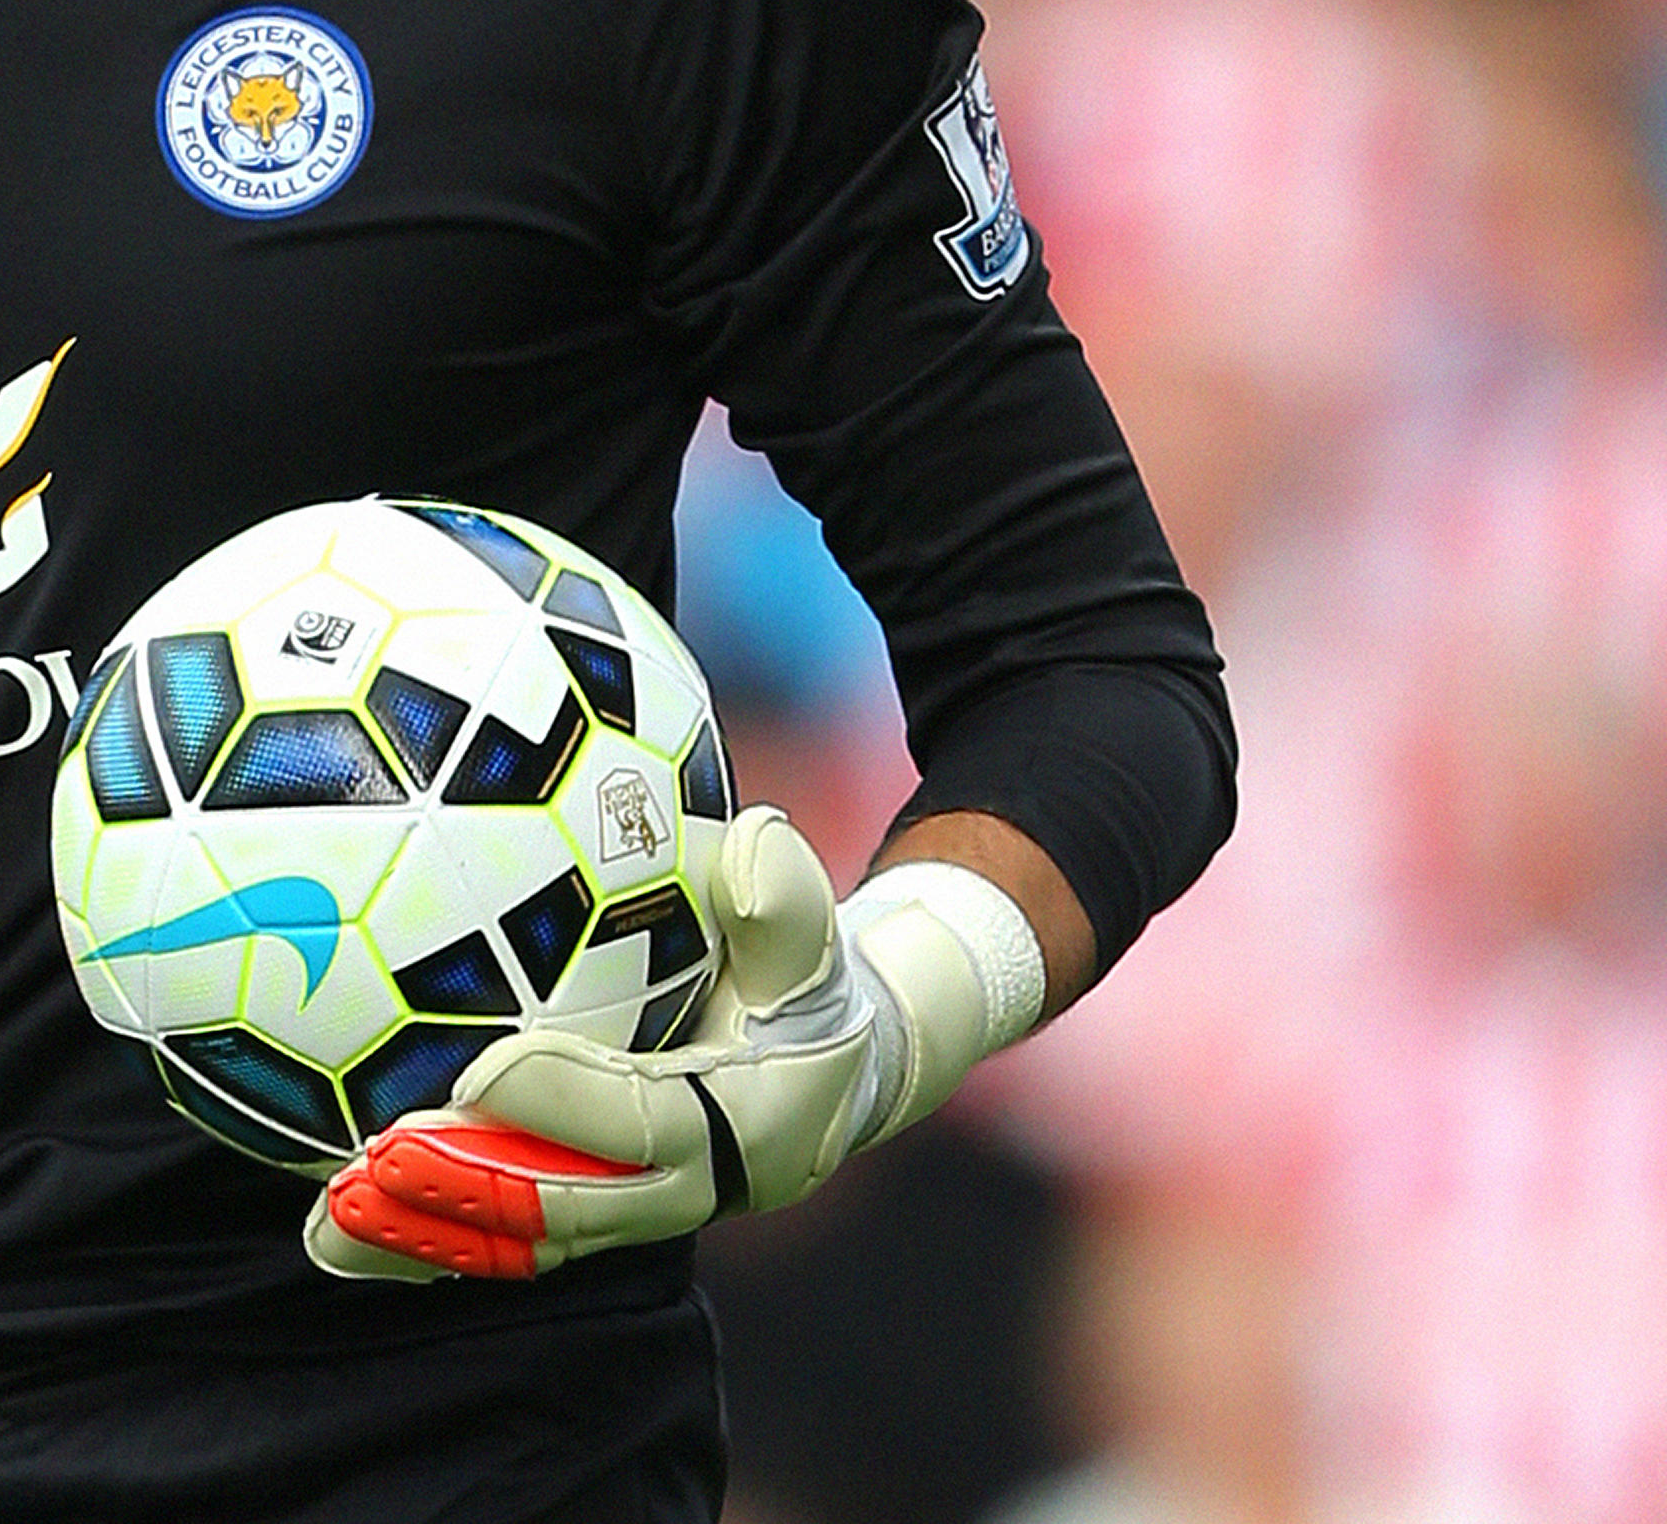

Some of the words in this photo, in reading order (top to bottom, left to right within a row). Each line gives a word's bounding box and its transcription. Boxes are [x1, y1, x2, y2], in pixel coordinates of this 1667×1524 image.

[176, 25, 306, 110] LEICESTER
[308, 42, 354, 96] CITY
[177, 126, 308, 200] FOOTBALL
[306, 112, 354, 183] CLUB
